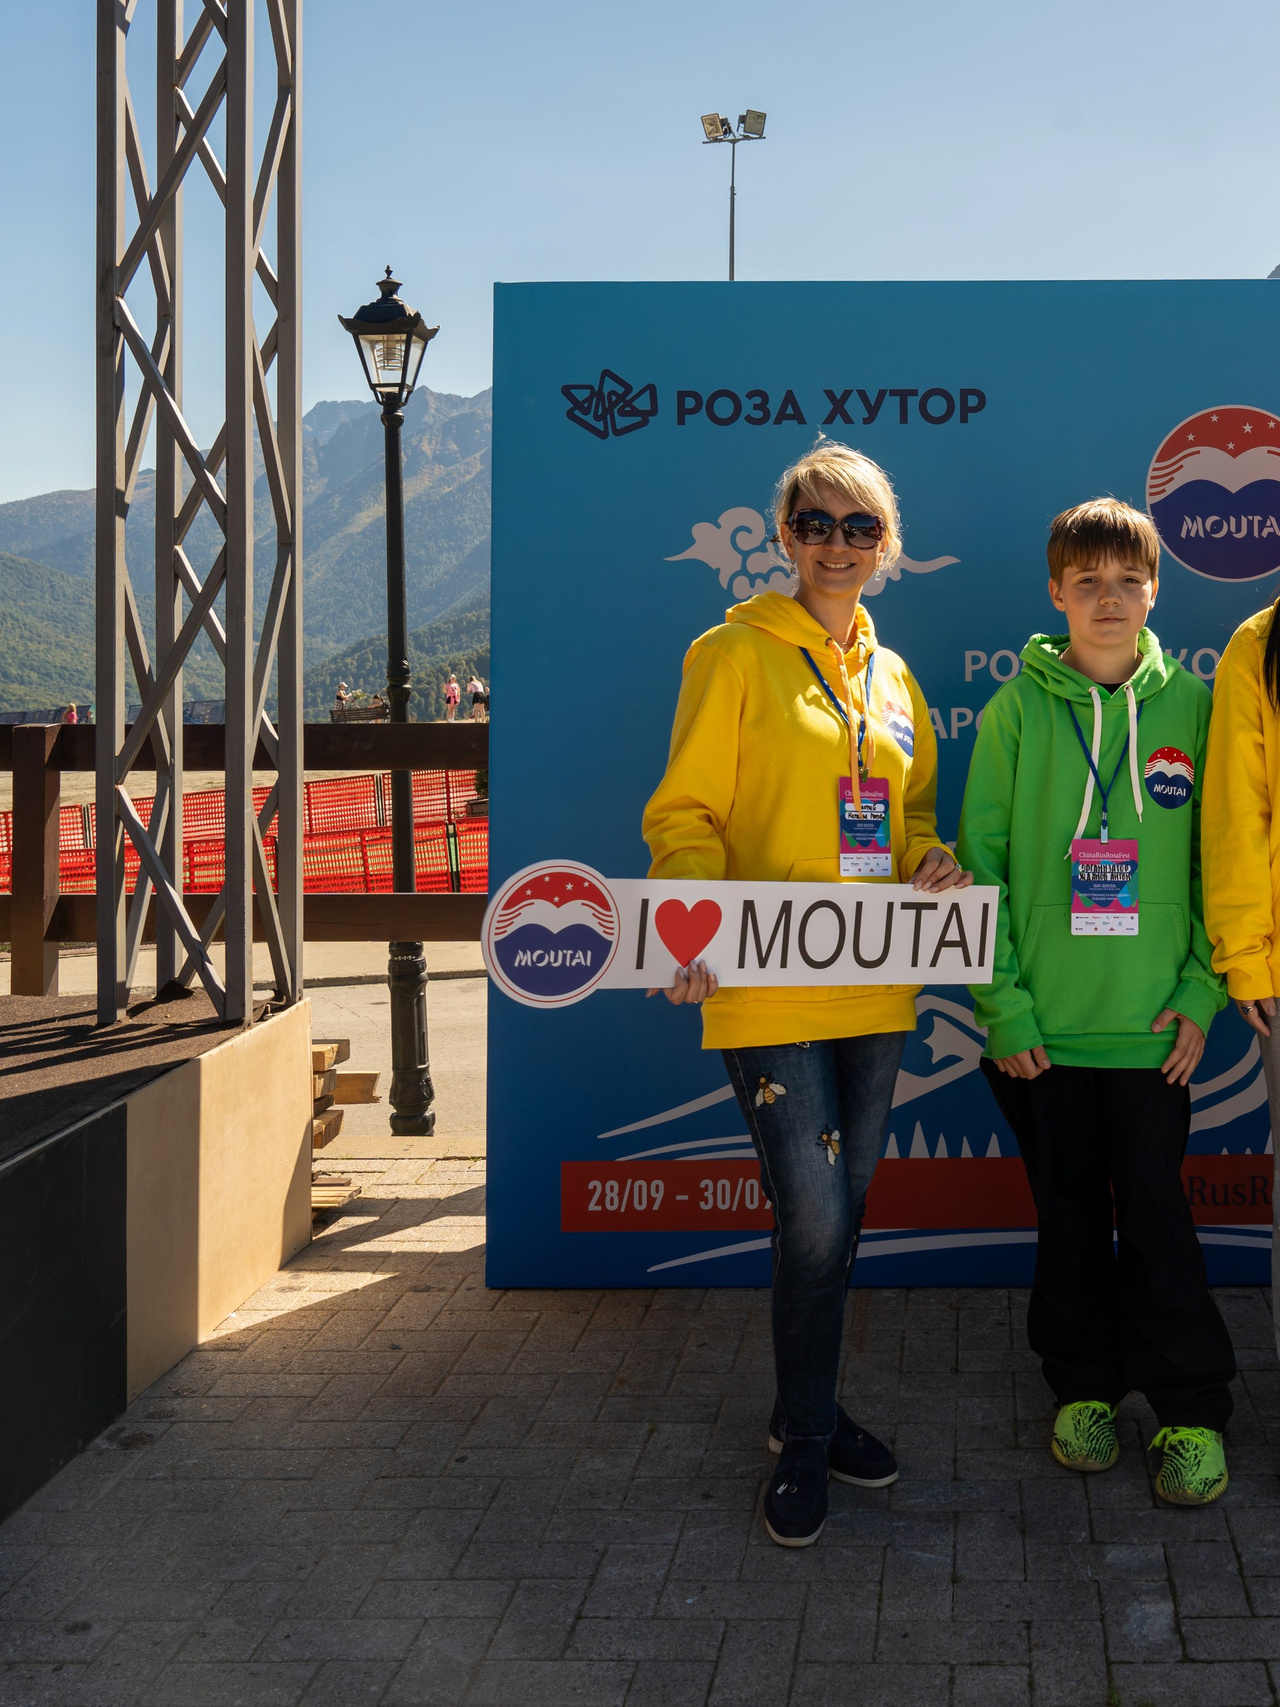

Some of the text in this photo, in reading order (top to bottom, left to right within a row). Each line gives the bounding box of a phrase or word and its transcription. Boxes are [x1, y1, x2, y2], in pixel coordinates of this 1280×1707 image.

[676, 388, 987, 426] РОЗА ХУТОР
[1153, 783, 1187, 797] MOUTAI
[634, 897, 990, 970] I MOUTAI
[513, 949, 592, 968] MOUTAI
[588, 1179, 666, 1212] 28/09
